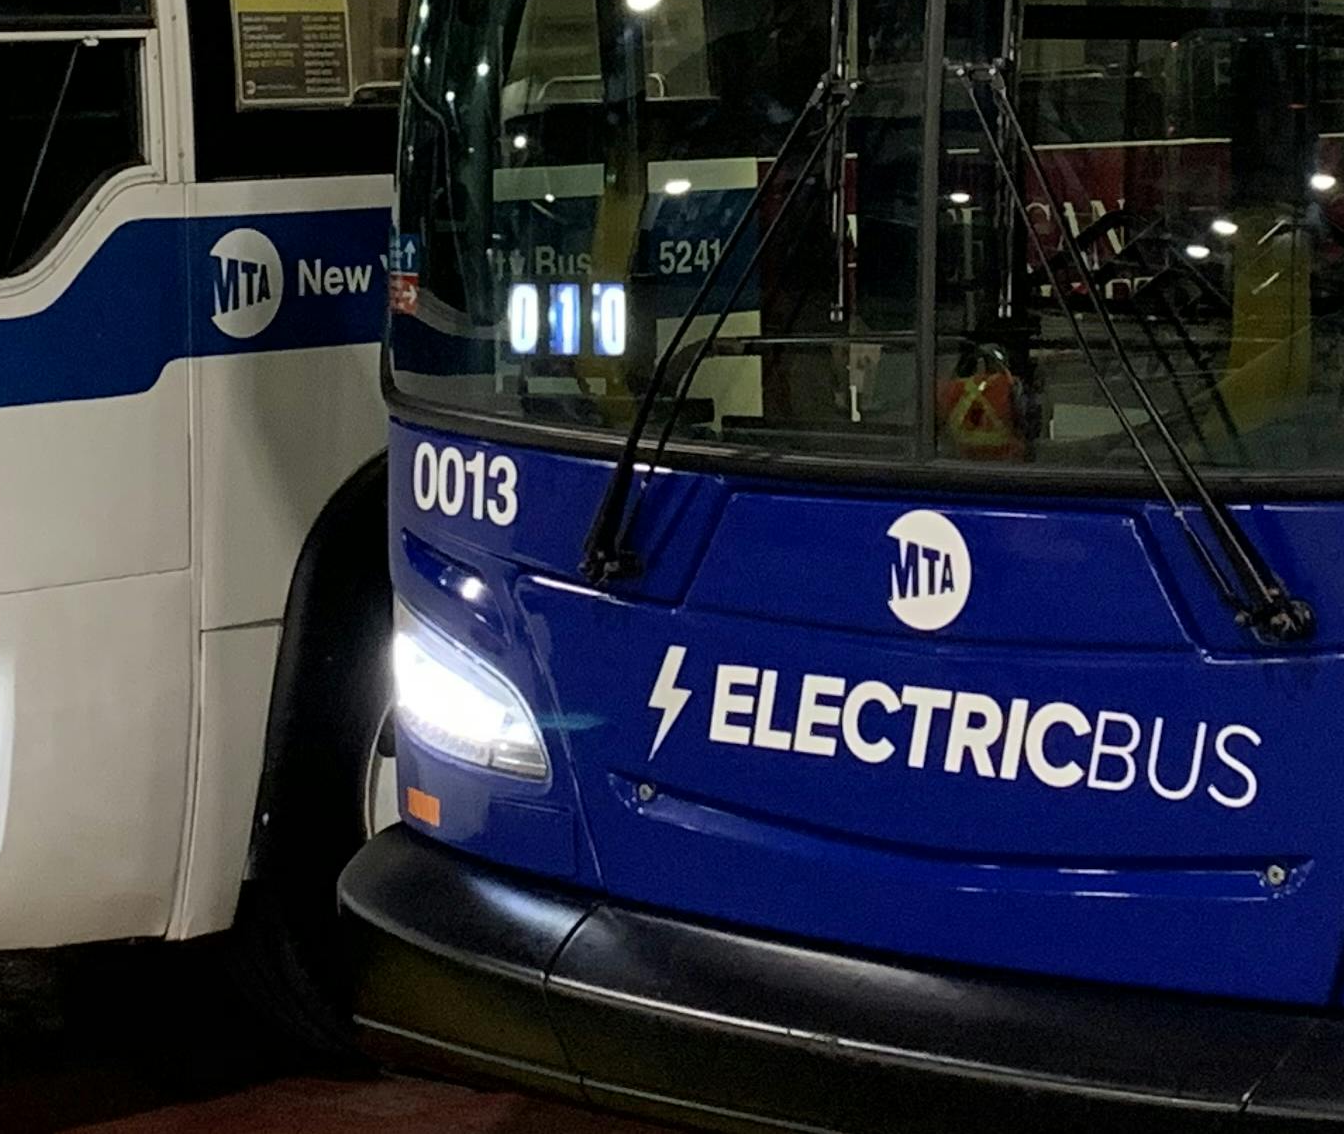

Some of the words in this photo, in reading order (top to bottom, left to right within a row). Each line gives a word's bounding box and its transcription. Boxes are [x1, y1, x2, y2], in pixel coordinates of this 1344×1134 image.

[659, 238, 723, 275] 5241
[298, 261, 372, 297] New
[413, 441, 518, 526] 0013
